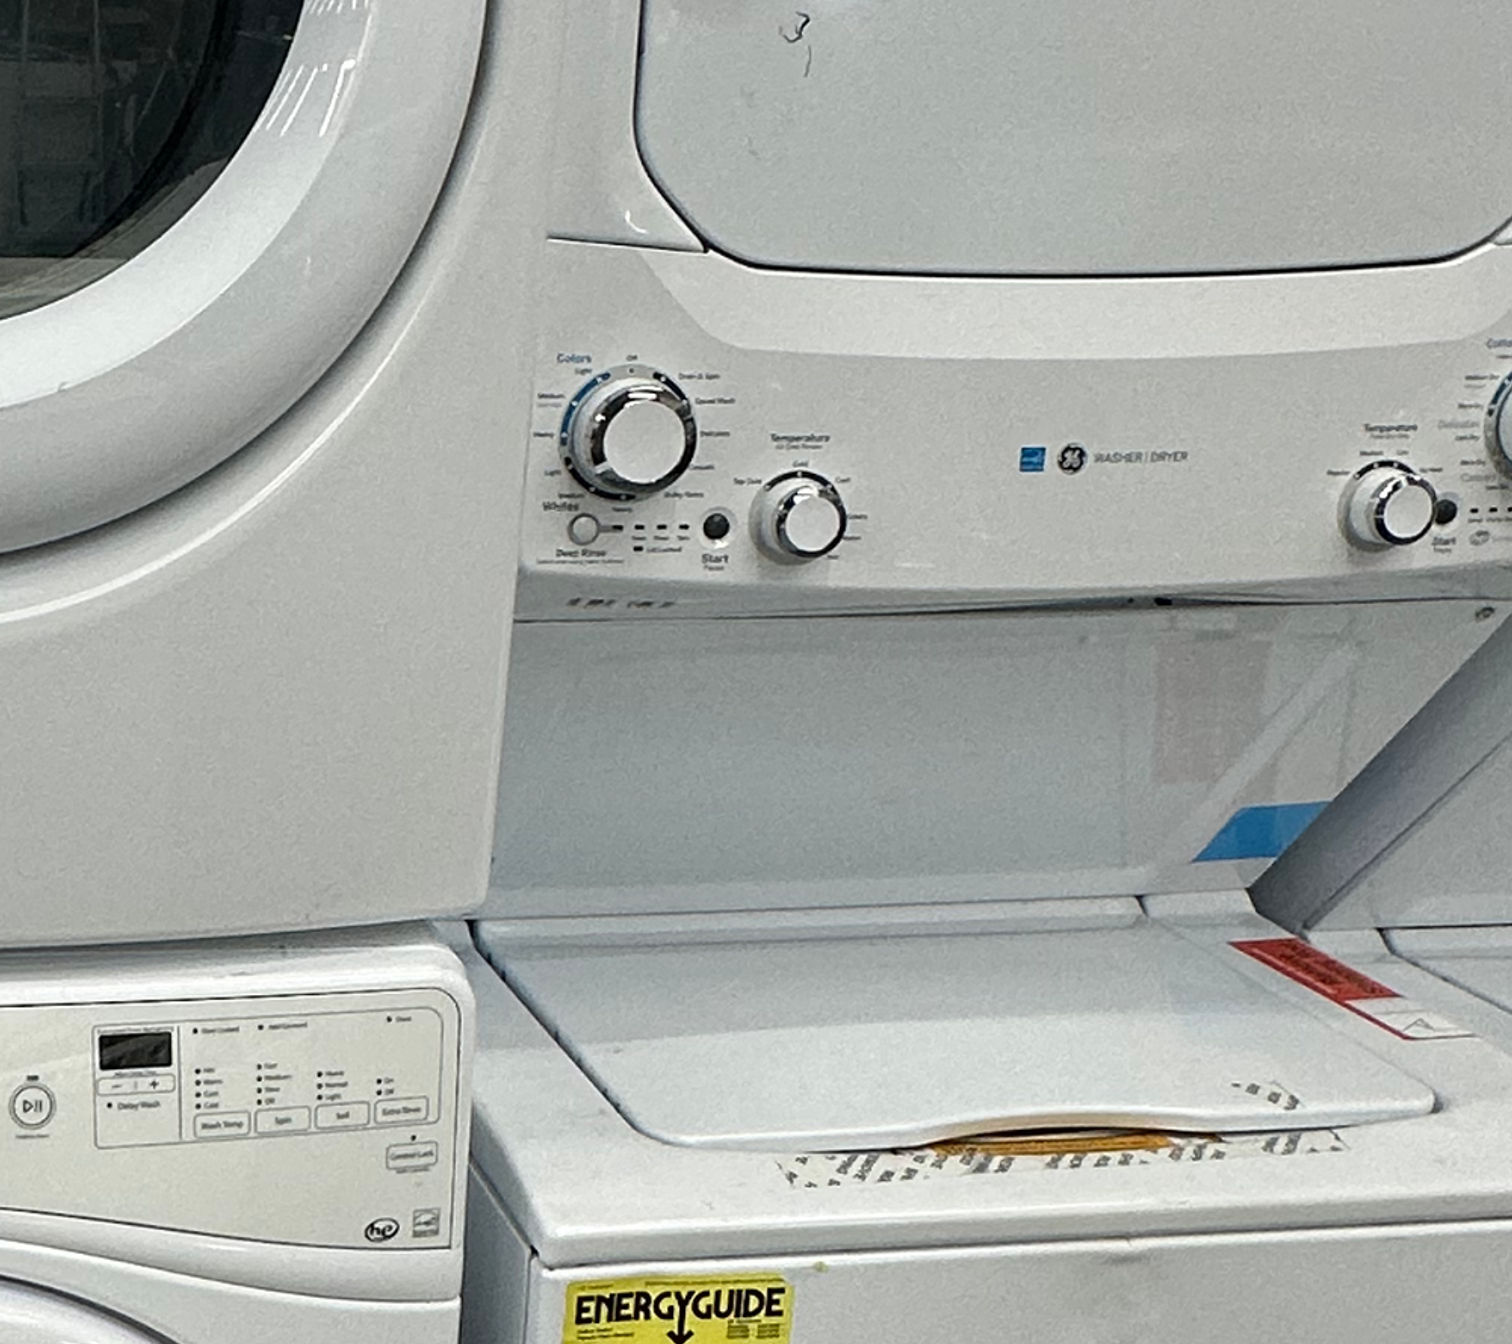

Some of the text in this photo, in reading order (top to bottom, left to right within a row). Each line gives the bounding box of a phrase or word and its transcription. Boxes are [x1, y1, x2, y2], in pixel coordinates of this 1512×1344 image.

[556, 353, 593, 364] Colors
[1364, 423, 1418, 432] Temperature
[770, 433, 830, 443] Temperature
[1094, 451, 1144, 464] WASHER
[1150, 451, 1189, 464] DRYER
[543, 501, 580, 512] Whites
[1432, 537, 1457, 546] Start
[556, 549, 607, 559] Deep Rinse
[702, 553, 729, 564] Start
[575, 1287, 786, 1327] ENERGYGUIDE
